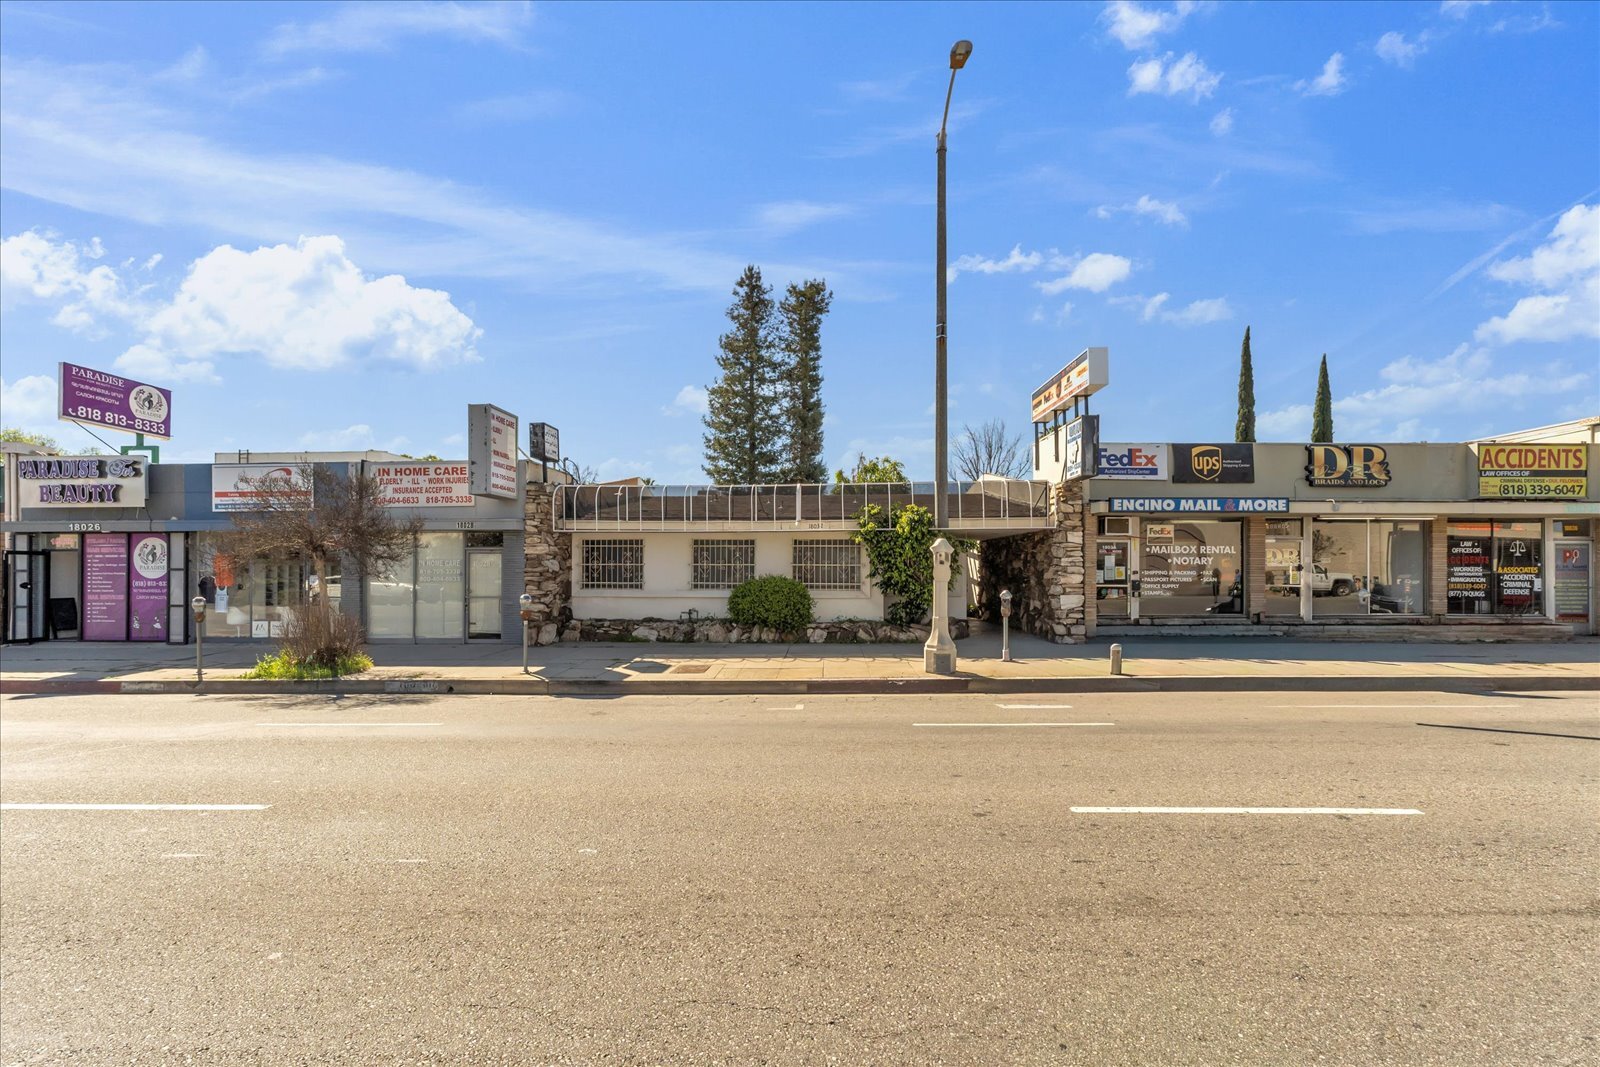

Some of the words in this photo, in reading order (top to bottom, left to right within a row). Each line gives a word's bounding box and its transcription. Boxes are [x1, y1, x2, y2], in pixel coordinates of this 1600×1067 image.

[71, 366, 124, 387] PARADISE
[77, 406, 101, 420] 818
[105, 412, 165, 434] 813-8333
[1098, 448, 1157, 467] FedEx
[1481, 447, 1583, 469] ACCIDENTS
[18, 459, 99, 479] PARADISE
[377, 468, 390, 476] IN
[394, 467, 430, 476] HOME
[434, 466, 467, 475] CARE
[1194, 456, 1220, 475] ups
[411, 477, 420, 485] ILL
[39, 484, 117, 503] BEAUTY
[392, 486, 423, 494] INSURANCE
[1499, 484, 1528, 496] (818)
[1529, 484, 1584, 495] 339-6047
[1113, 499, 1176, 512] ENCINO
[1180, 499, 1221, 512] MAIL
[1224, 499, 1237, 512] &
[1238, 499, 1287, 512] MORE
[69, 523, 101, 531] 18026
[1149, 527, 1171, 535] FedEx
[1150, 545, 1197, 554] MAILBOX
[1200, 545, 1236, 554] RENTAL
[1172, 557, 1214, 565] NOTARY
